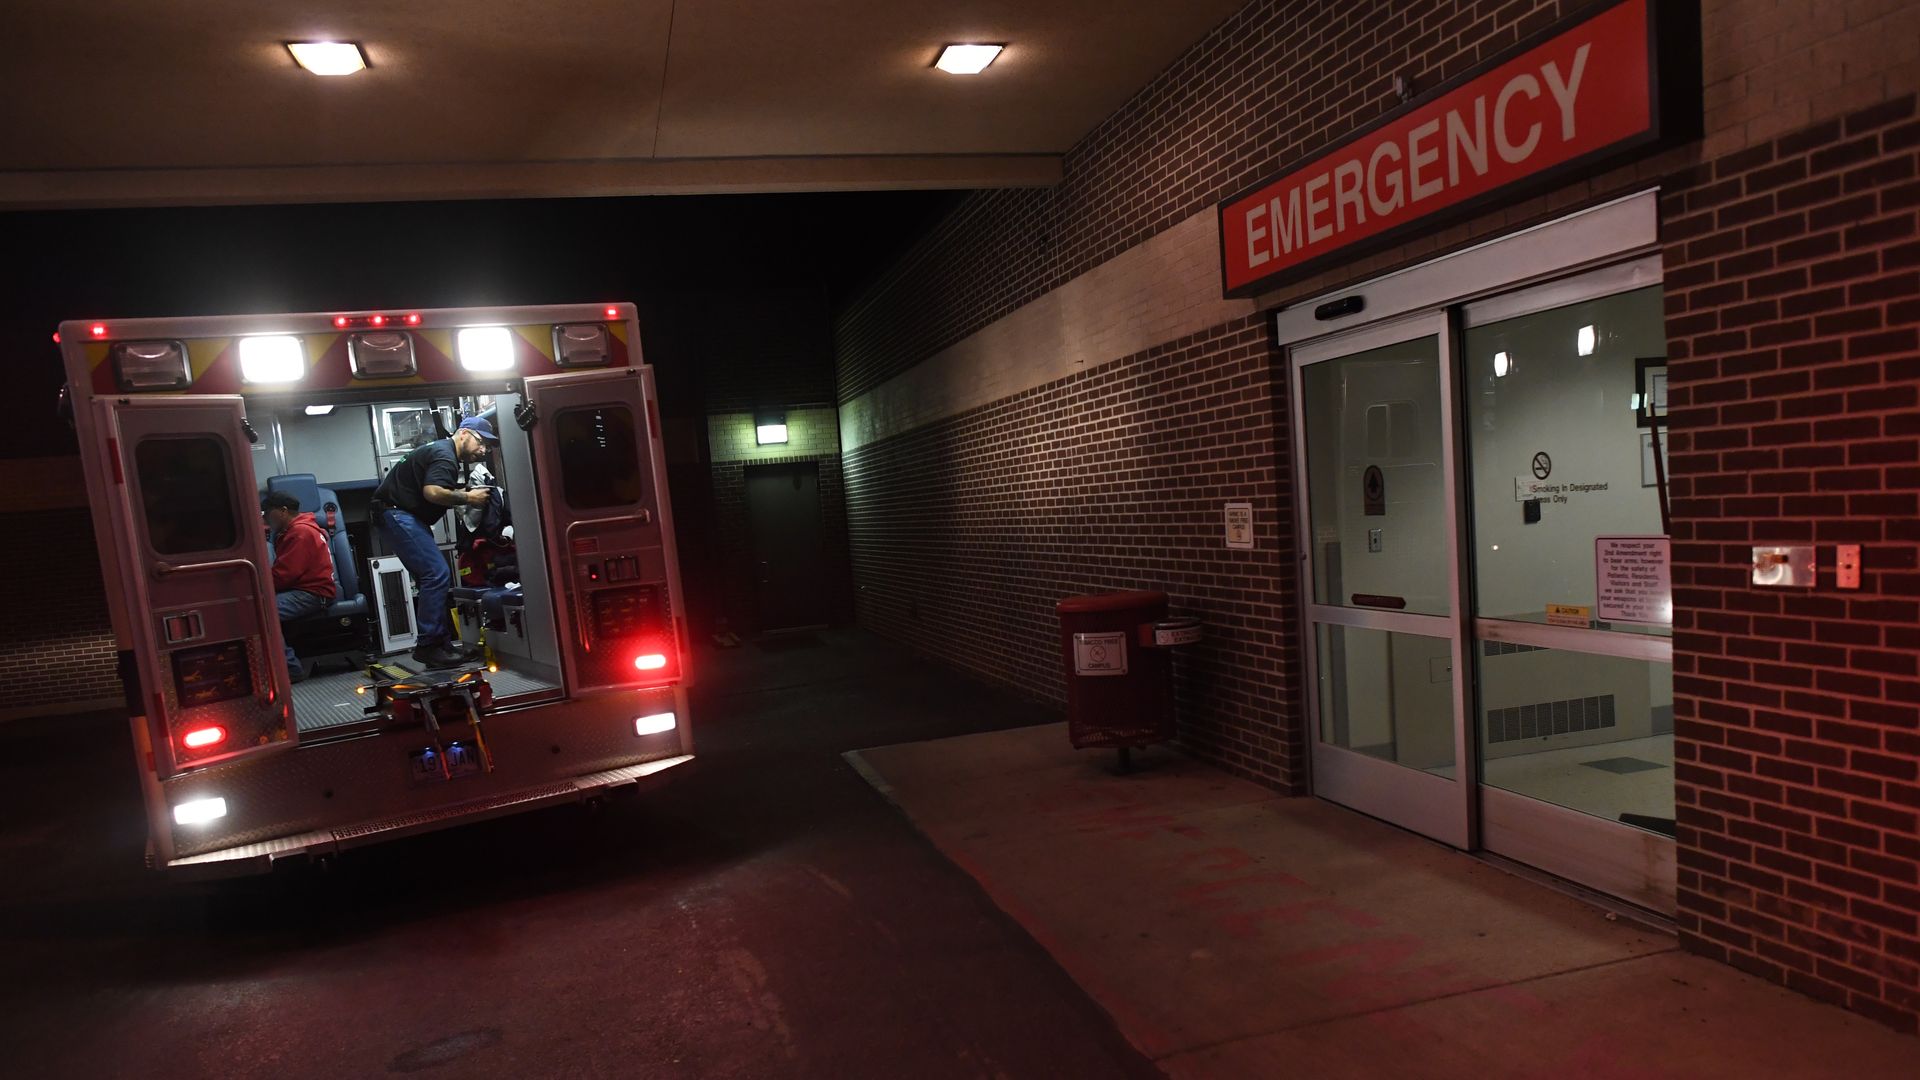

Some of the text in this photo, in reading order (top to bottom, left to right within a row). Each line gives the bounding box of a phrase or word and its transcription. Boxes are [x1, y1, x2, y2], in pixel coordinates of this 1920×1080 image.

[1245, 42, 1591, 269] EMERGENCY
[1532, 485, 1560, 493] Smoking
[1569, 482, 1608, 493] Designated
[1553, 495, 1567, 504] Only
[1649, 550, 1662, 558] right
